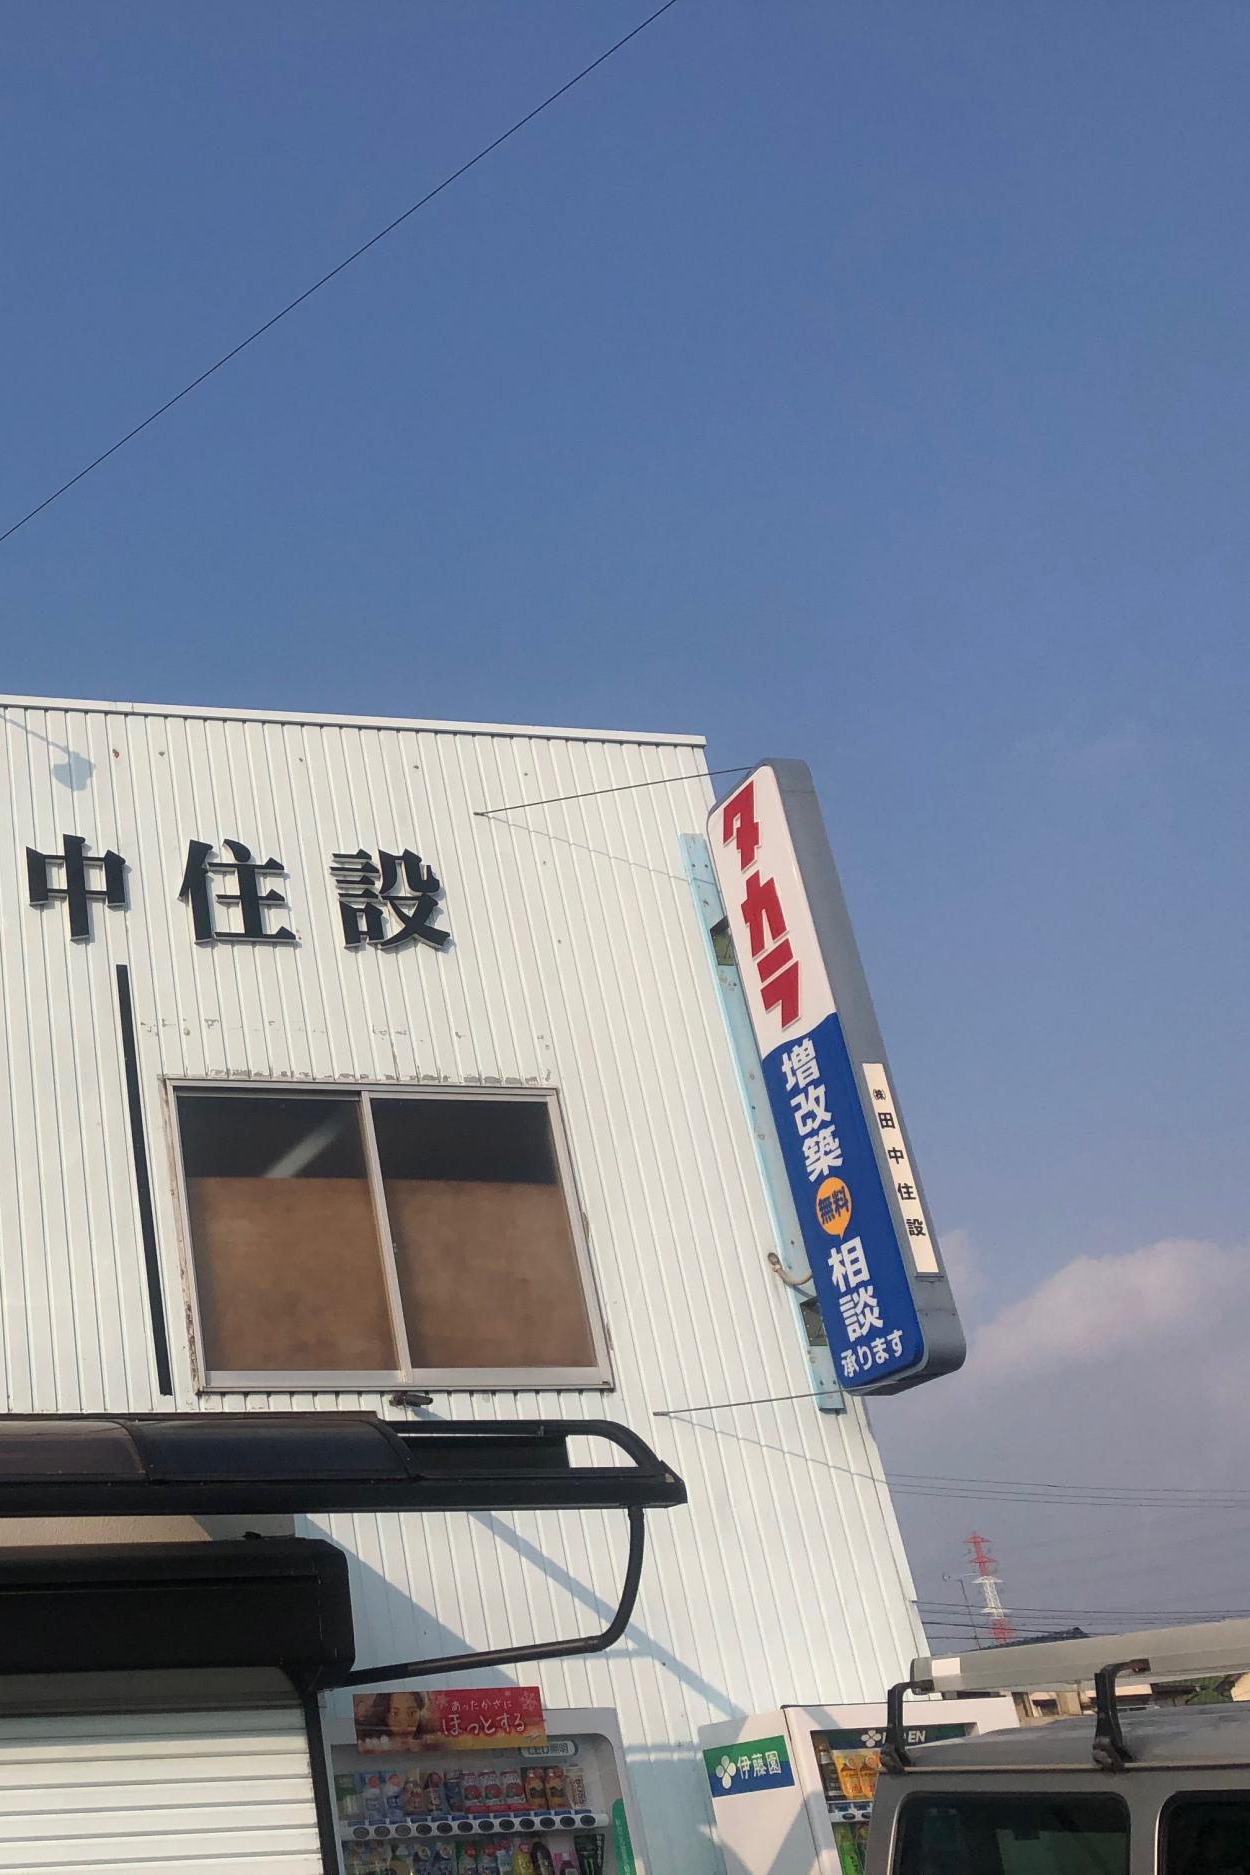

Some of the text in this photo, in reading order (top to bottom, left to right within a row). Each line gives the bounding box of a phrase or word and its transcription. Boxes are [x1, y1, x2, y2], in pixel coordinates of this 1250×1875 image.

[723, 779, 800, 1031] タカラ
[781, 1037, 844, 1182] 増改築
[817, 1185, 849, 1225] 無料
[828, 1236, 884, 1342] 相談
[840, 1329, 903, 1378] 承ります
[442, 1712, 525, 1736] ほっとする
[450, 1700, 513, 1712] あったかさに
[881, 1729, 926, 1744] IEN
[737, 1750, 782, 1780] 伊藤園
